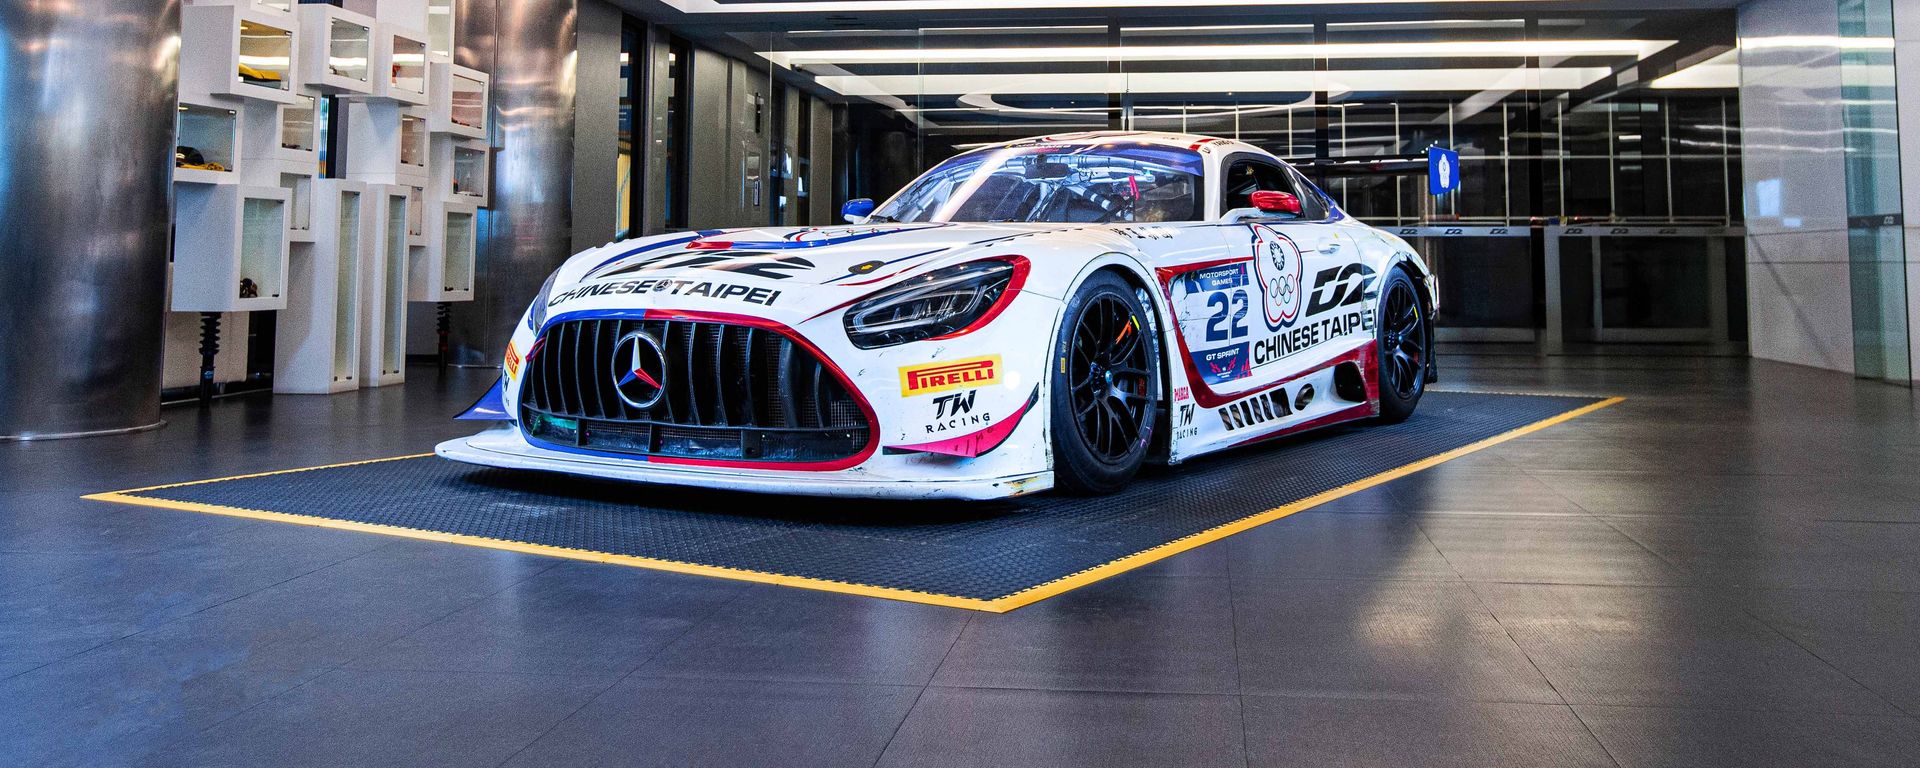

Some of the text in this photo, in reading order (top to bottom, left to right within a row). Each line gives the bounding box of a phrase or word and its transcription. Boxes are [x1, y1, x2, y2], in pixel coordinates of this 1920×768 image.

[1199, 268, 1239, 280] MOTORSPORT
[1211, 277, 1233, 287] GAMES
[548, 279, 781, 307] CHINESE TAIPEI
[1305, 262, 1379, 318] D2
[1205, 289, 1249, 342] 22
[1205, 347, 1240, 361] GT SPRINT
[1254, 322, 1319, 364] CHINESE
[907, 360, 994, 390] PIRELLI
[932, 390, 977, 420] TW
[1180, 403, 1195, 427] TW
[925, 412, 991, 434] RACING
[1176, 427, 1198, 440] RACING
